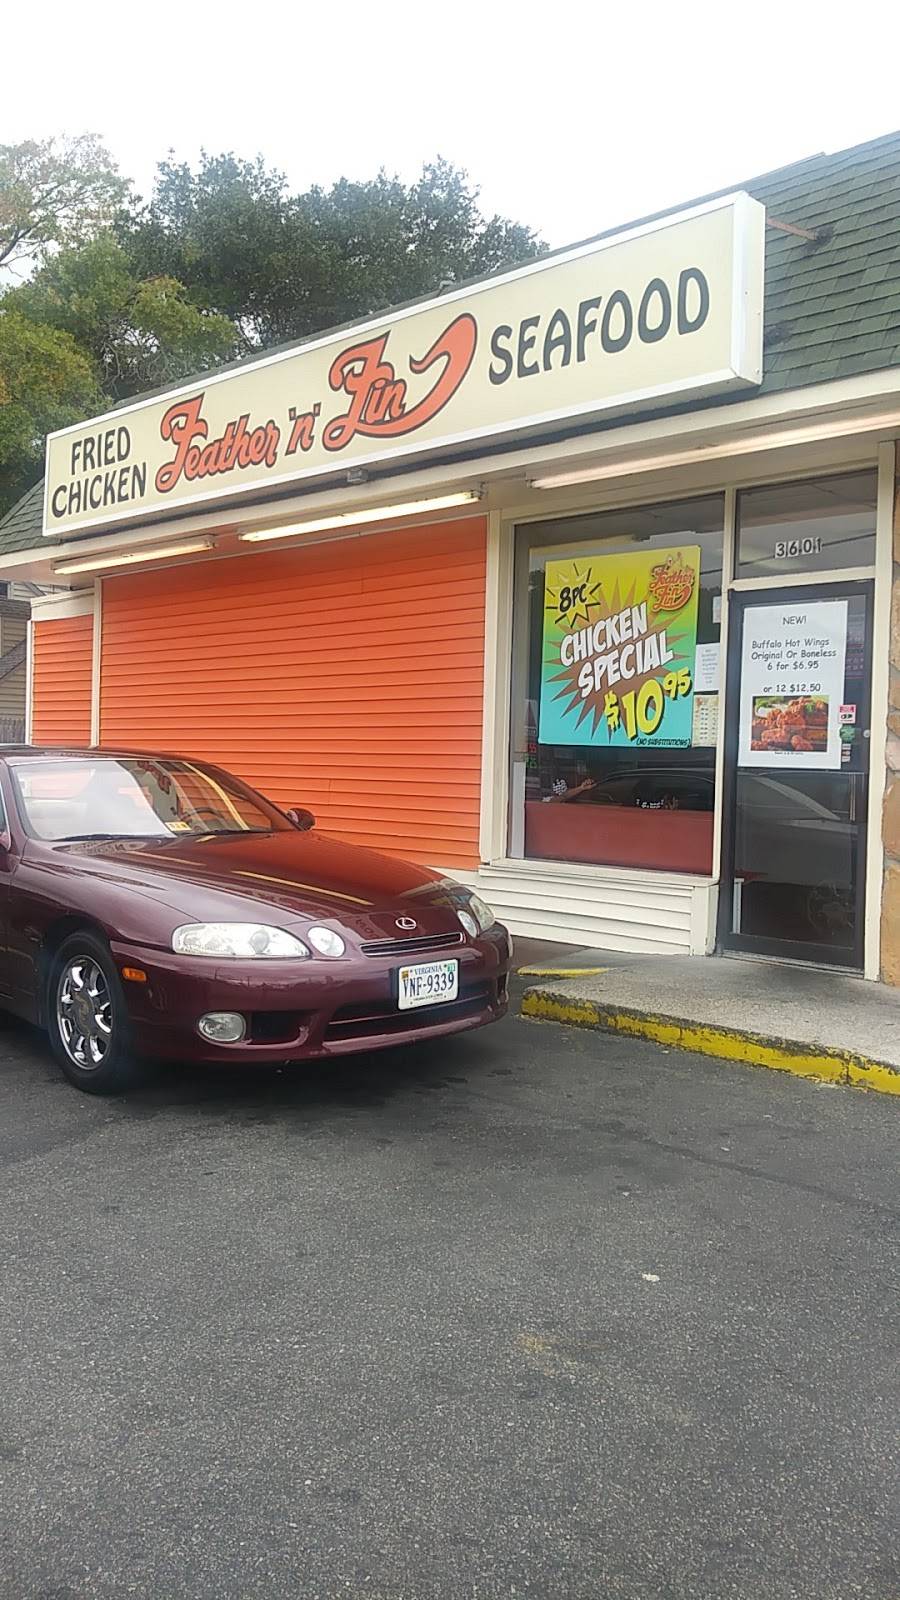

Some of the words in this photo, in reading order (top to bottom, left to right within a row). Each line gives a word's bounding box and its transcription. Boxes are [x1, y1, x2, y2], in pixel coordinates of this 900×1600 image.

[488, 267, 710, 386] SEAFOOD
[70, 426, 131, 476] FRIED
[155, 392, 281, 493] Feather
[51, 462, 147, 518] CHICKEN
[776, 537, 821, 557] 3601
[782, 615, 807, 625] NEW!
[560, 602, 648, 667] CHICKEN
[752, 640, 782, 649] Buffalo
[785, 638, 801, 648] Hot
[804, 638, 830, 649] Wings
[578, 630, 674, 699] SPECIAL
[751, 651, 783, 662] Original
[786, 650, 798, 659] Or
[801, 649, 837, 658] Boneless
[767, 662, 773, 671] 6
[776, 661, 789, 670] for
[792, 660, 819, 670] $6.95
[776, 684, 787, 693] 12
[790, 683, 821, 693] $12.50
[415, 965, 443, 975] VIRGINIA
[403, 972, 455, 998] VNF-9339
